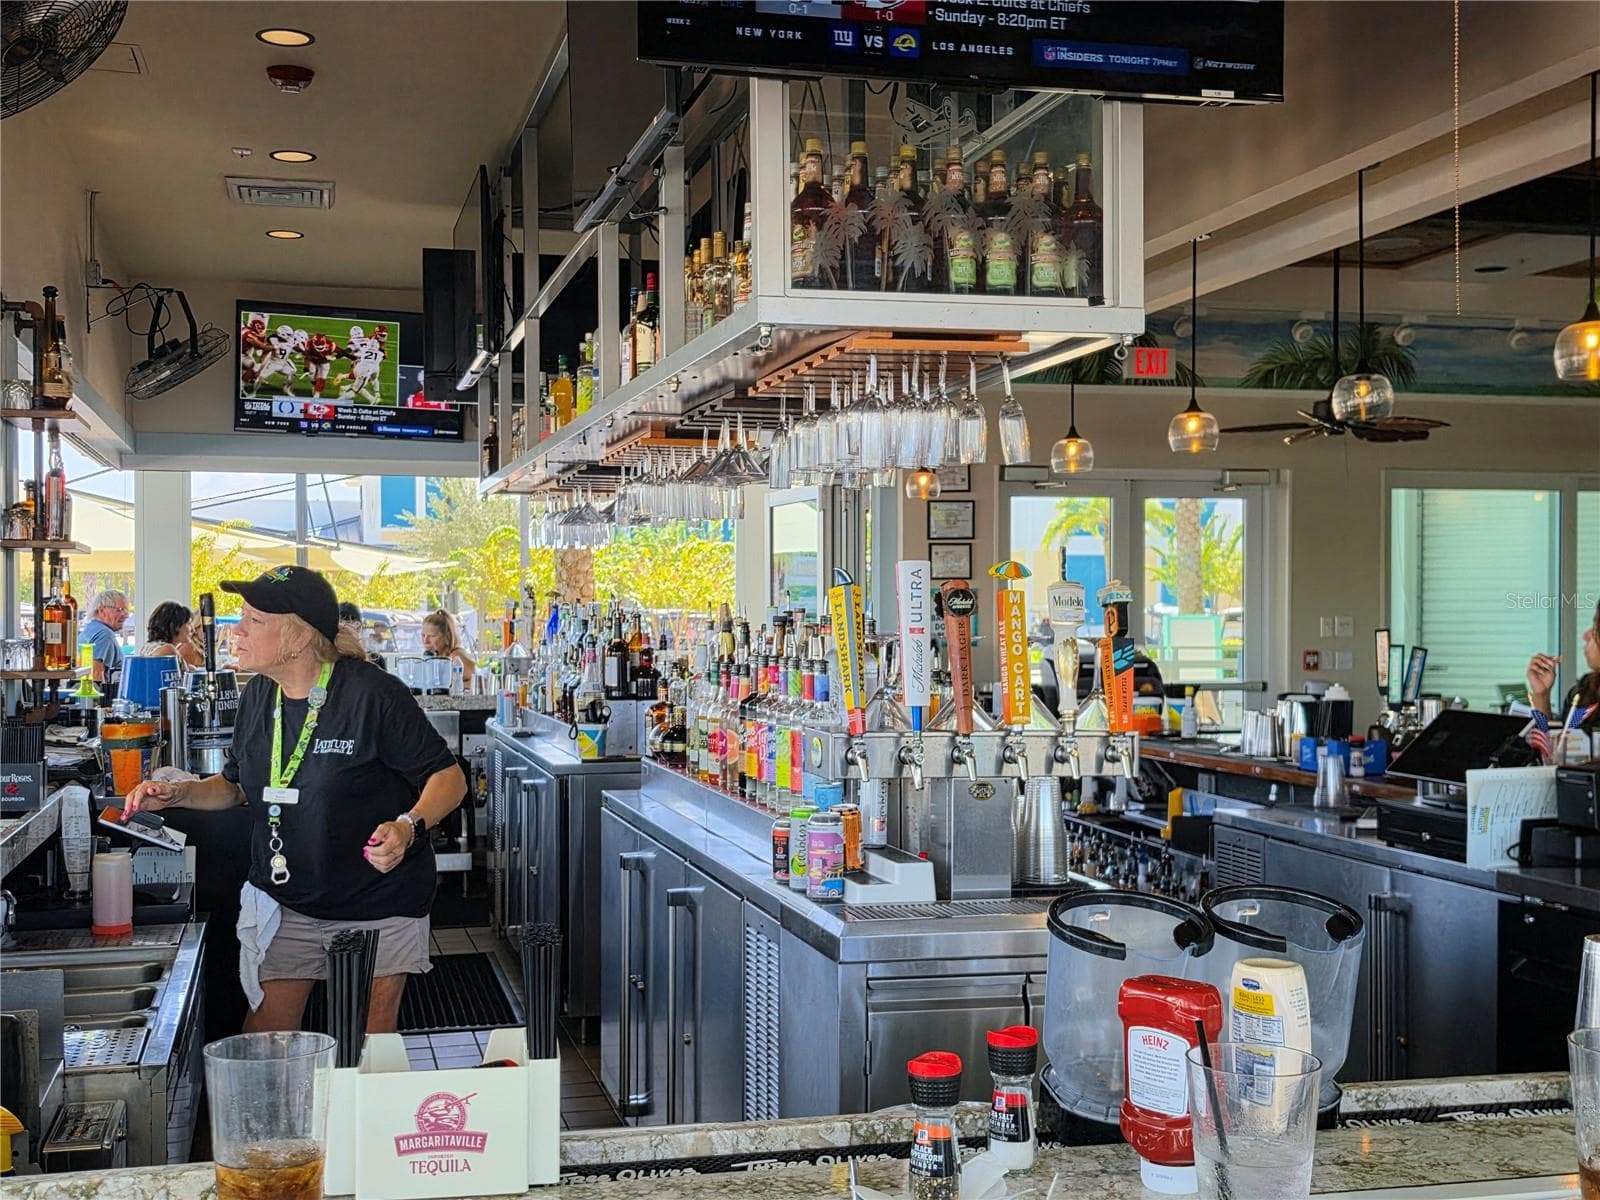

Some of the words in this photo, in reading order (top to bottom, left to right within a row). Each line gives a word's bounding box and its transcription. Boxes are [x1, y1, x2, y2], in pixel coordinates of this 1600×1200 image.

[1048, 0, 1091, 13] Chiefs
[874, 10, 894, 21] 1-0
[935, 8, 985, 27] Sunday
[997, 12, 1047, 30] 8:20pm
[1050, 16, 1067, 30] ET
[736, 27, 763, 37] NEW
[769, 29, 803, 40] YORK
[863, 35, 884, 48] VS
[932, 41, 955, 51] LOS
[960, 43, 1014, 56] ANGELES
[1057, 51, 1103, 63] INSIDERS
[1108, 54, 1149, 66] TONIGHT
[364, 351, 378, 360] 21
[1136, 347, 1169, 375] EXIT
[910, 568, 923, 623] ULTRA
[1053, 595, 1083, 608] Modelo
[1009, 591, 1023, 656] MANGO
[958, 622, 969, 660] LAGER
[911, 638, 925, 694] Michelob
[960, 665, 969, 697] DARK
[1013, 662, 1026, 714] CART
[1142, 1034, 1169, 1051] HEINZ
[399, 1135, 483, 1151] MARGARITAVILLE
[409, 1158, 471, 1176] TEQUILA
